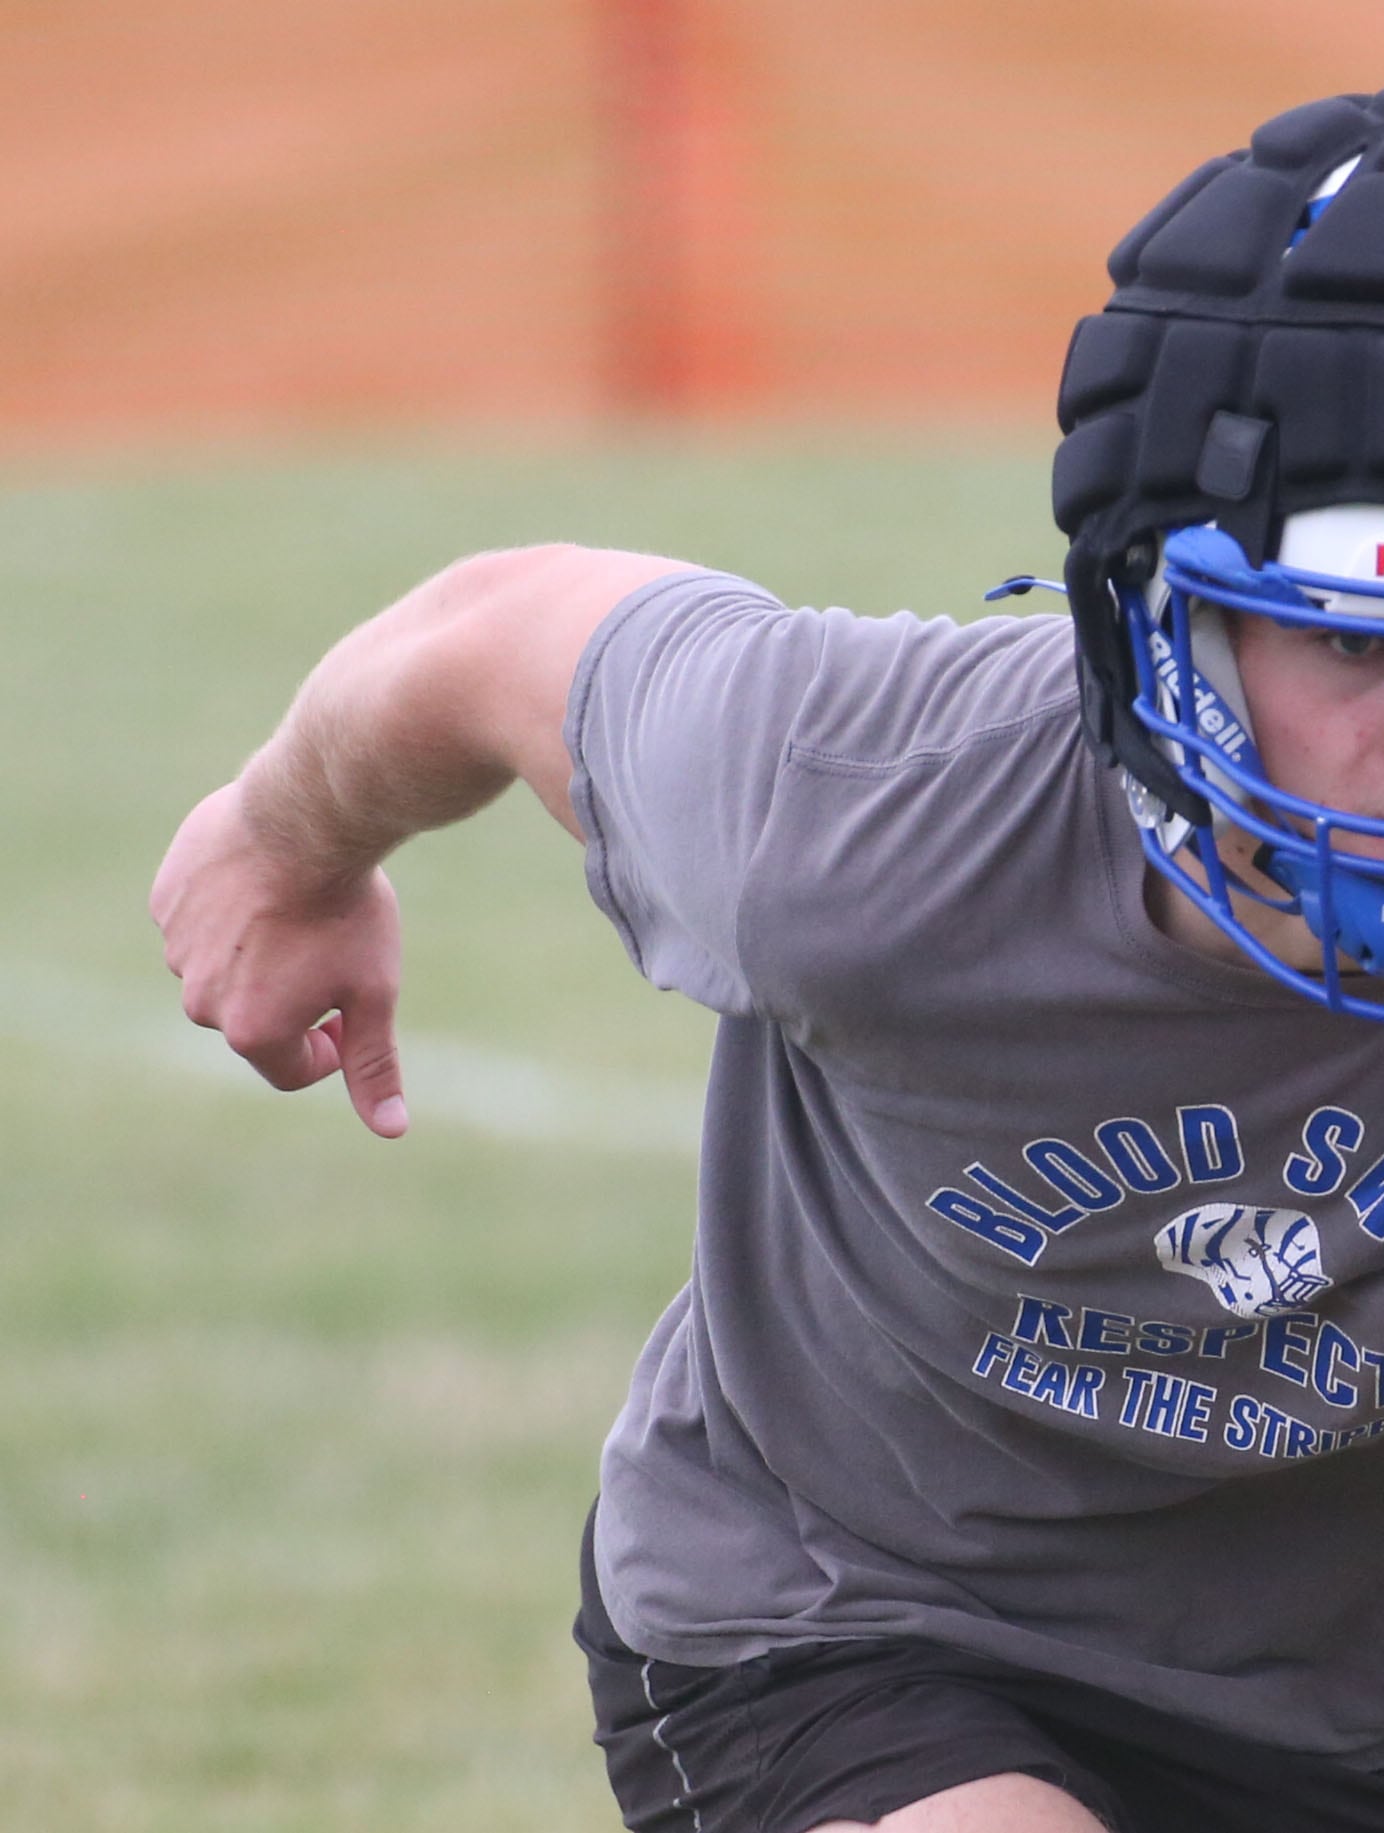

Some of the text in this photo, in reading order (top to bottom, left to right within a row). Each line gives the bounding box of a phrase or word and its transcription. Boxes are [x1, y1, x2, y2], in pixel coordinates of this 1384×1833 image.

[926, 1104, 1245, 1267] BLOOD
[972, 1331, 1105, 1420] FEAR
[1118, 1367, 1217, 1443] THE
